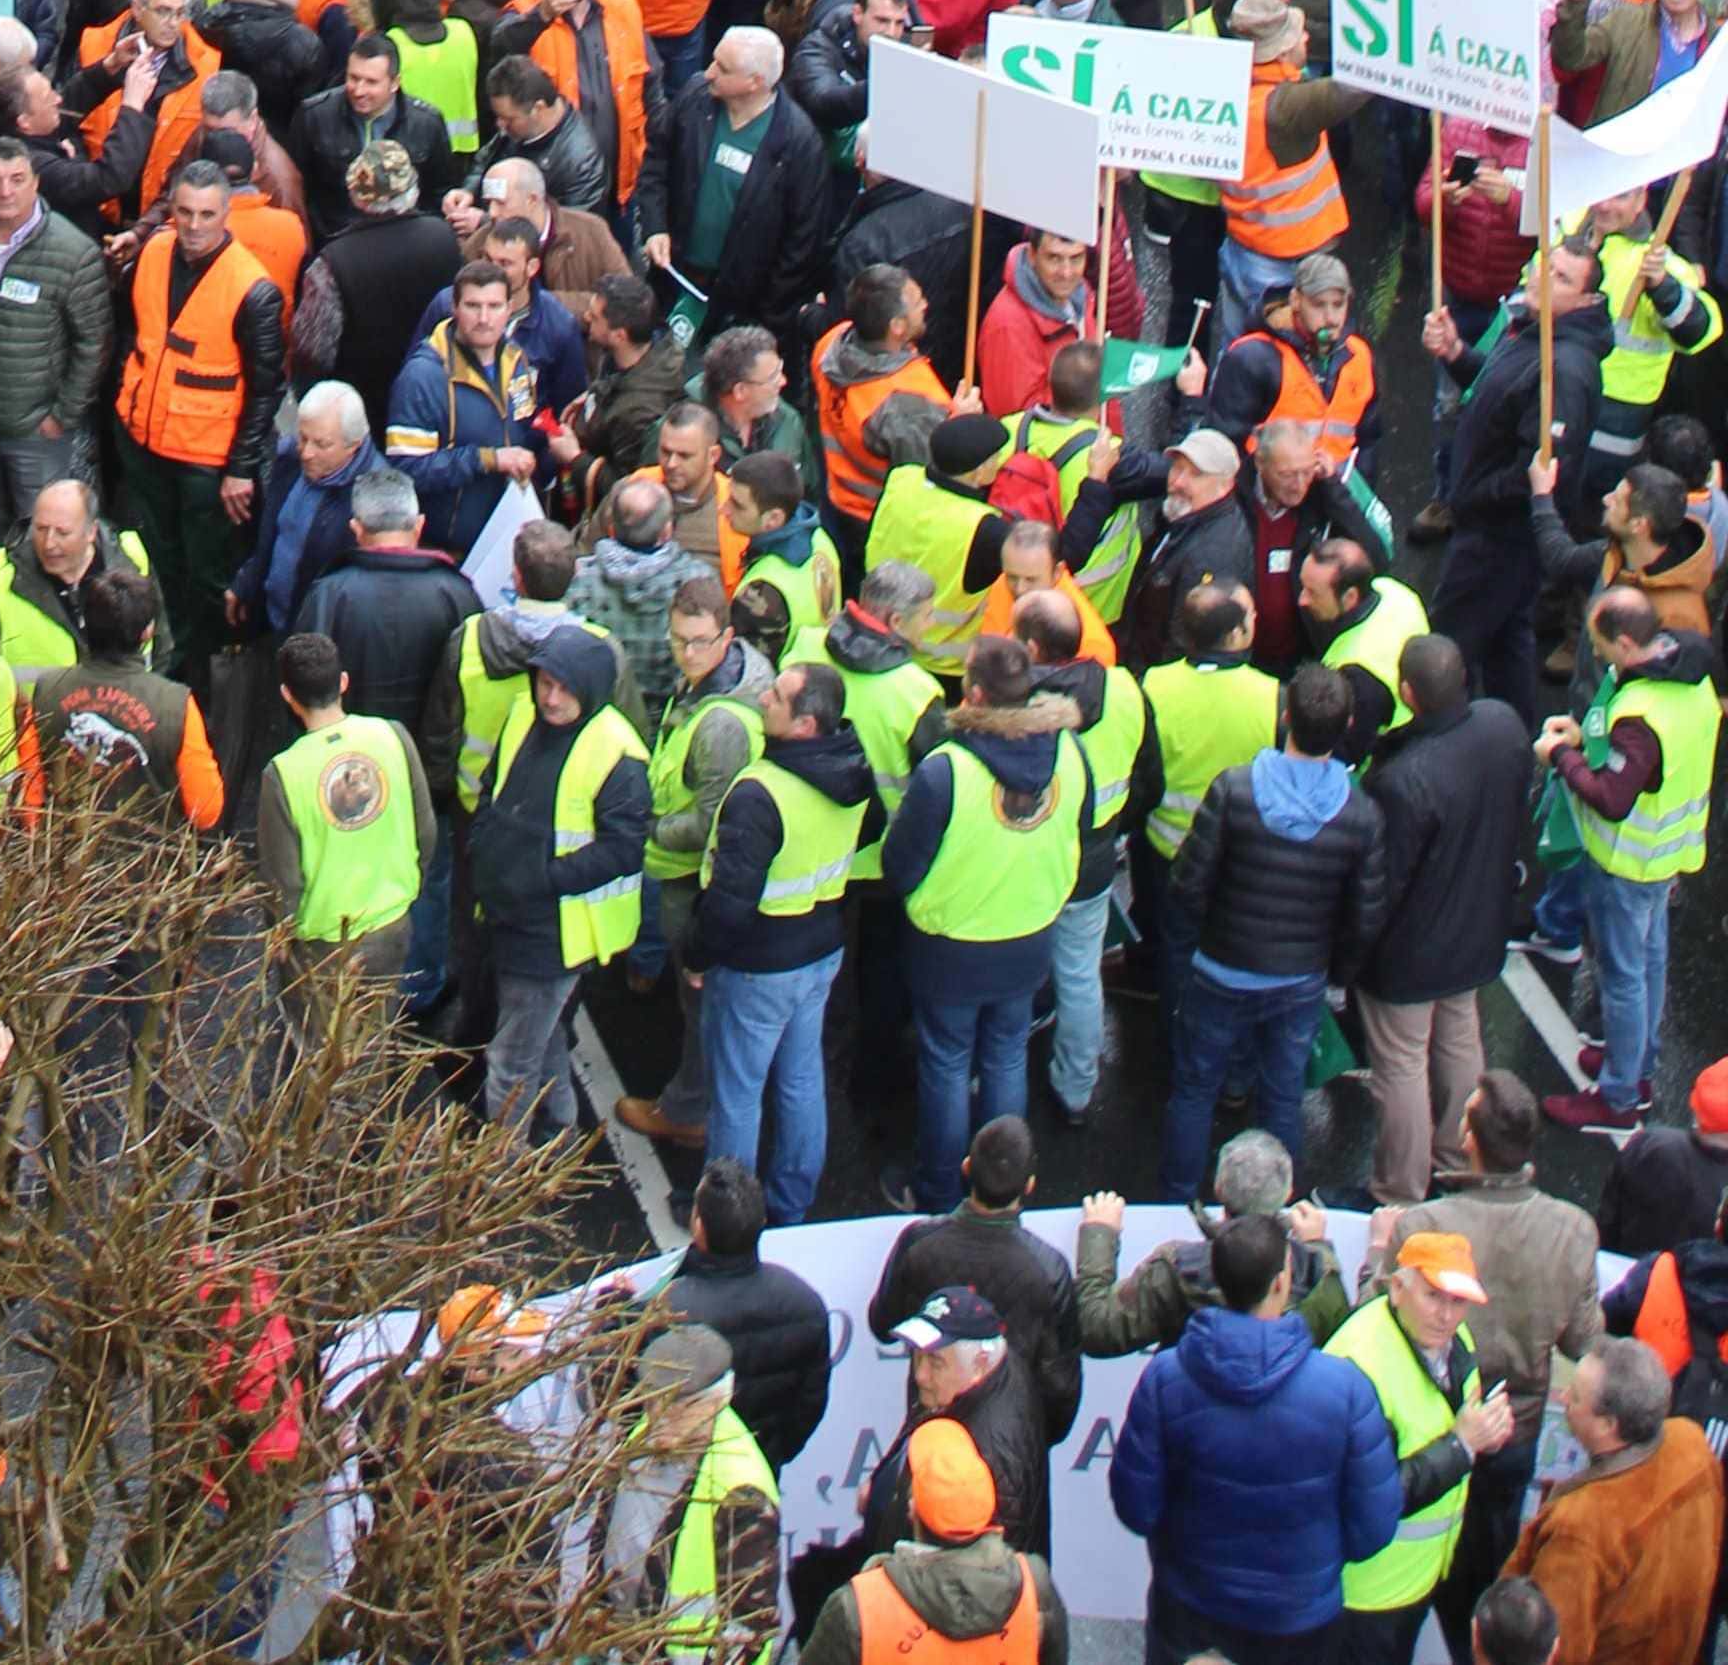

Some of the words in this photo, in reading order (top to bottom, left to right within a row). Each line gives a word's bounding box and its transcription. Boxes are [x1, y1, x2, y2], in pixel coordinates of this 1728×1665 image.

[1428, 24, 1446, 58] Á
[1457, 36, 1530, 81] CAZA
[1001, 38, 1103, 108] SÍ
[1111, 83, 1134, 116] Á
[1148, 93, 1239, 127] CAZA
[1132, 147, 1174, 163] PESCA
[1178, 153, 1239, 171] CASELAS
